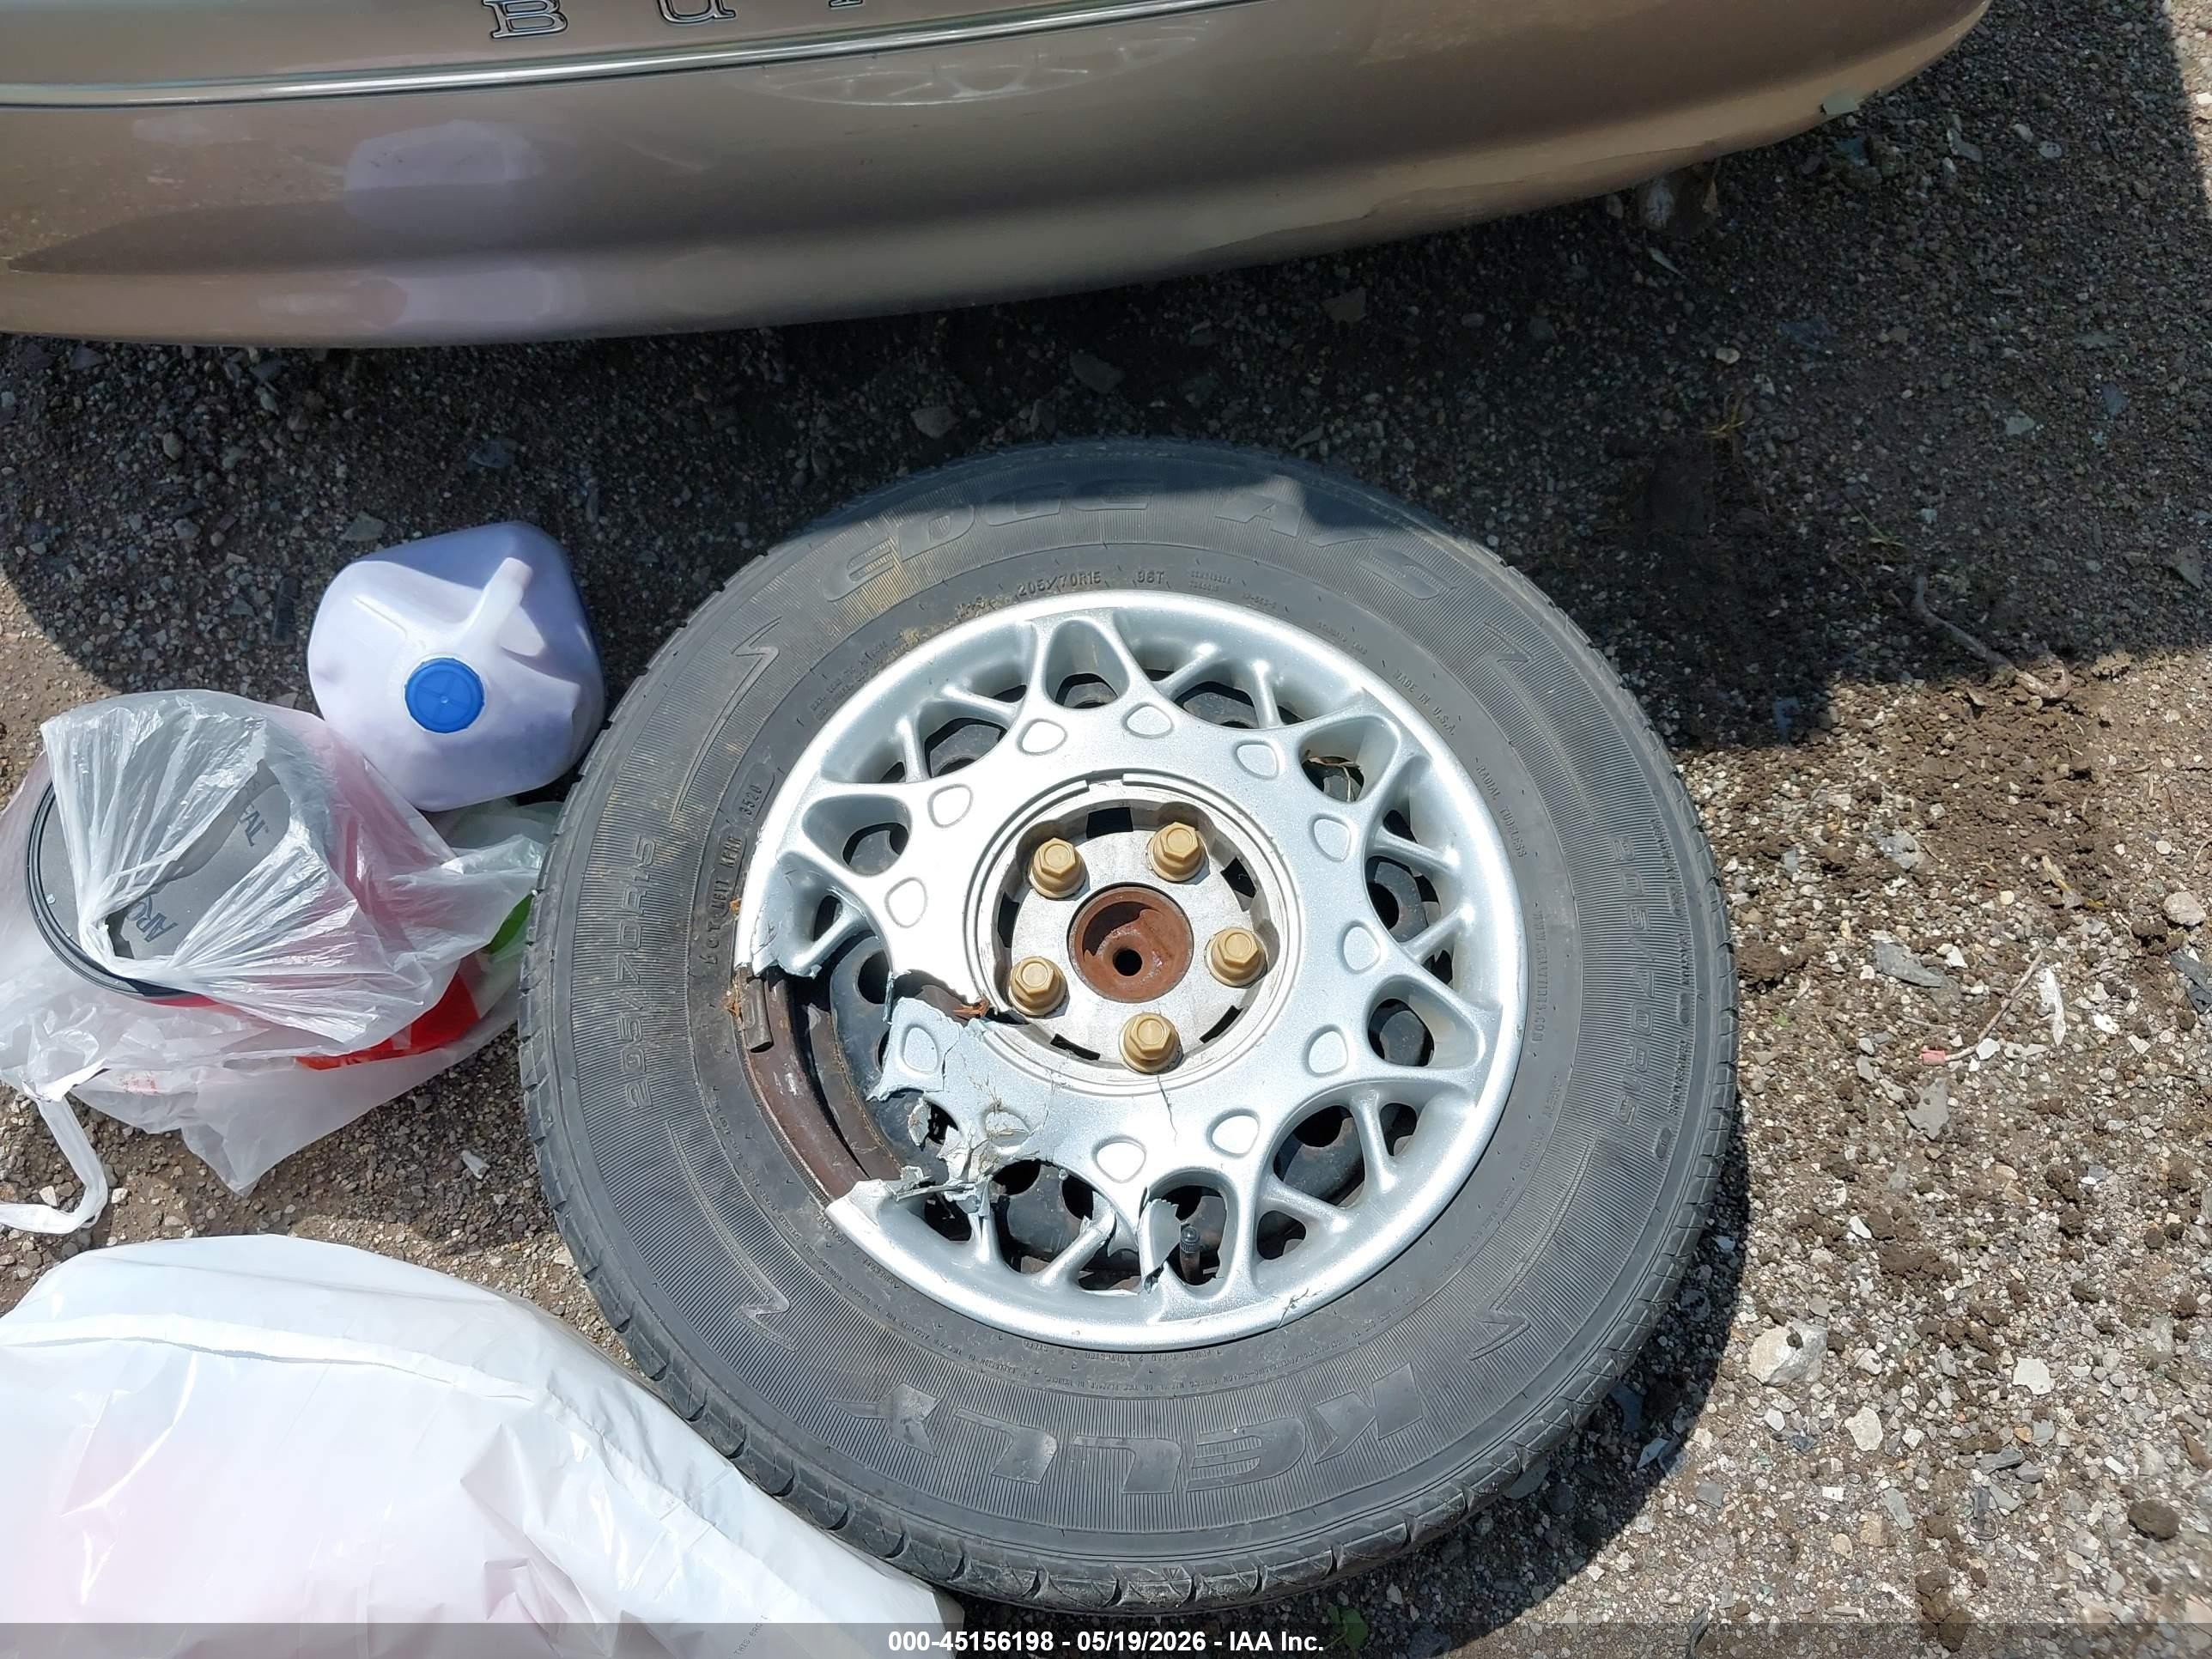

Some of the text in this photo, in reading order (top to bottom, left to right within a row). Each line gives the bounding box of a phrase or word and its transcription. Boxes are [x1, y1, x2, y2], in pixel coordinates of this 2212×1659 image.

[1017, 571, 1101, 597] 205/70R15
[1214, 492, 1455, 599] A/S
[738, 784, 763, 817] 3520
[617, 835, 657, 1107] 205/70R15
[1609, 836, 1656, 1126] 205/70R15
[831, 1363, 1424, 1494] KELLY
